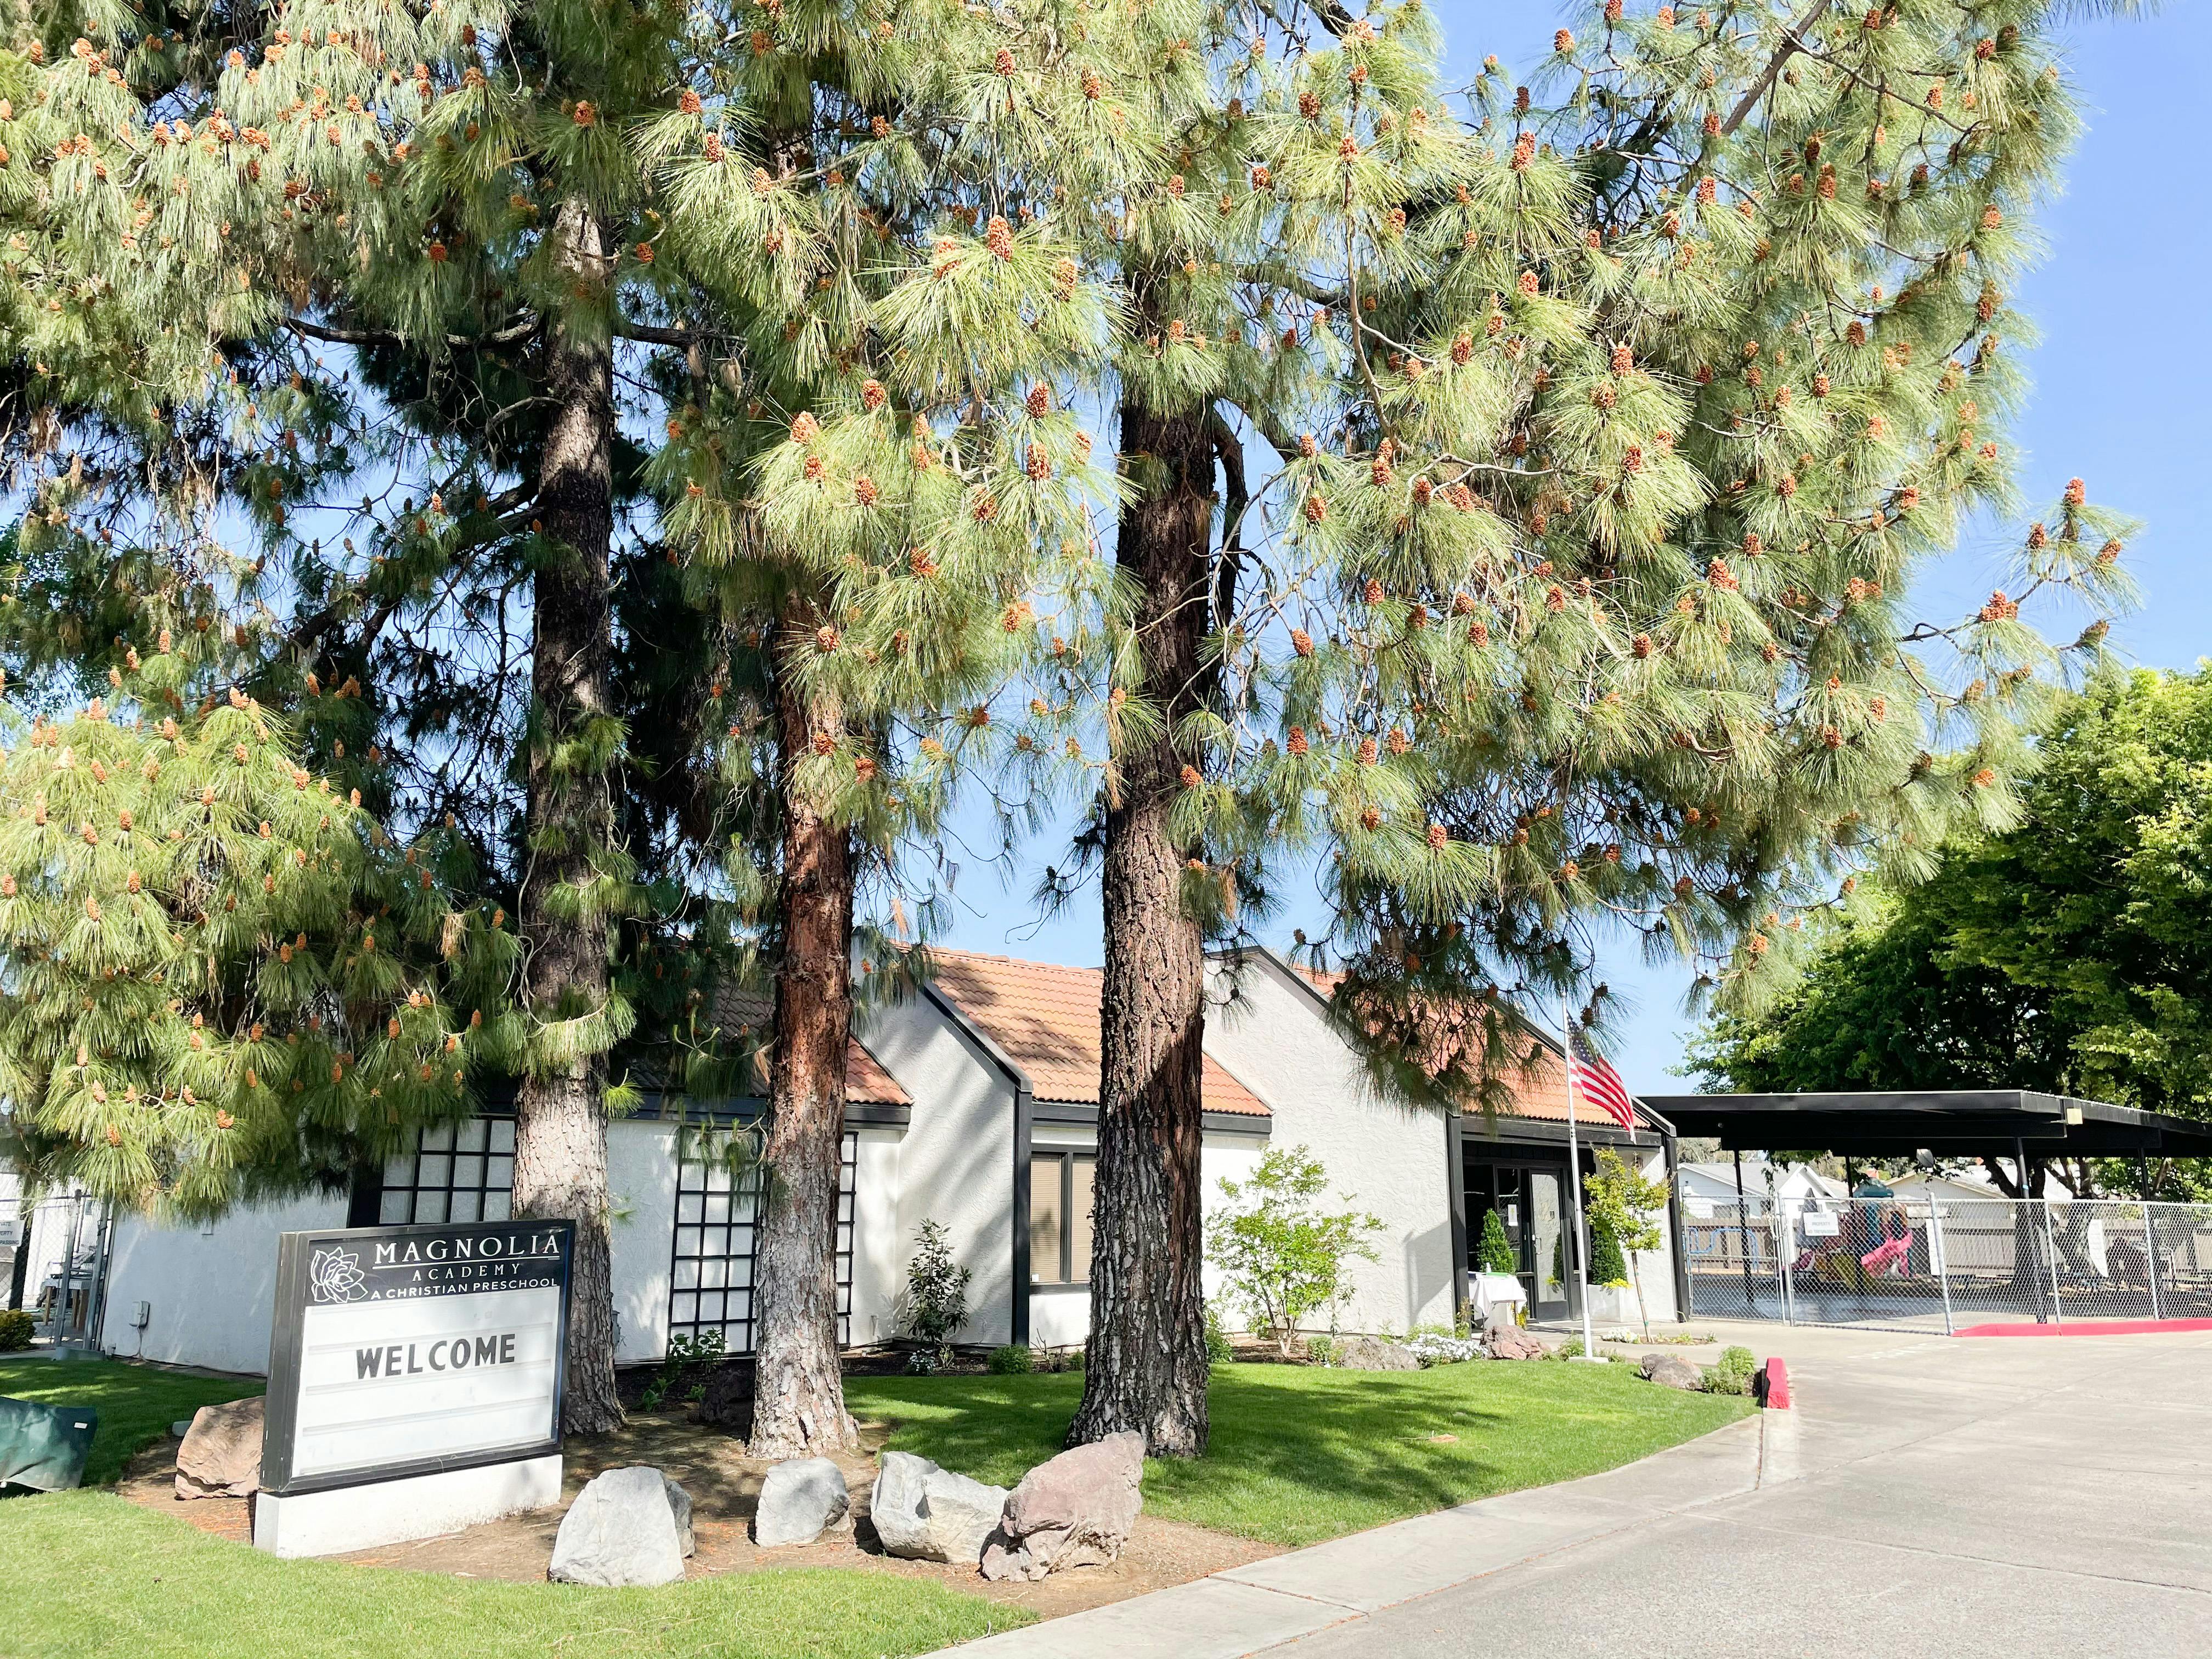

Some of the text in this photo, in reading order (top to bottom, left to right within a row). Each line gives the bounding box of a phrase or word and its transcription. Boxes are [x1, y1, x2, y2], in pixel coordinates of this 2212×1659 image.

[375, 1235, 559, 1263] MAGNOLIA
[413, 1263, 520, 1282] ACADEMY
[370, 1278, 557, 1300] A CHRISTIAN PRESCHOOL
[356, 1334, 515, 1379] WELCOME
